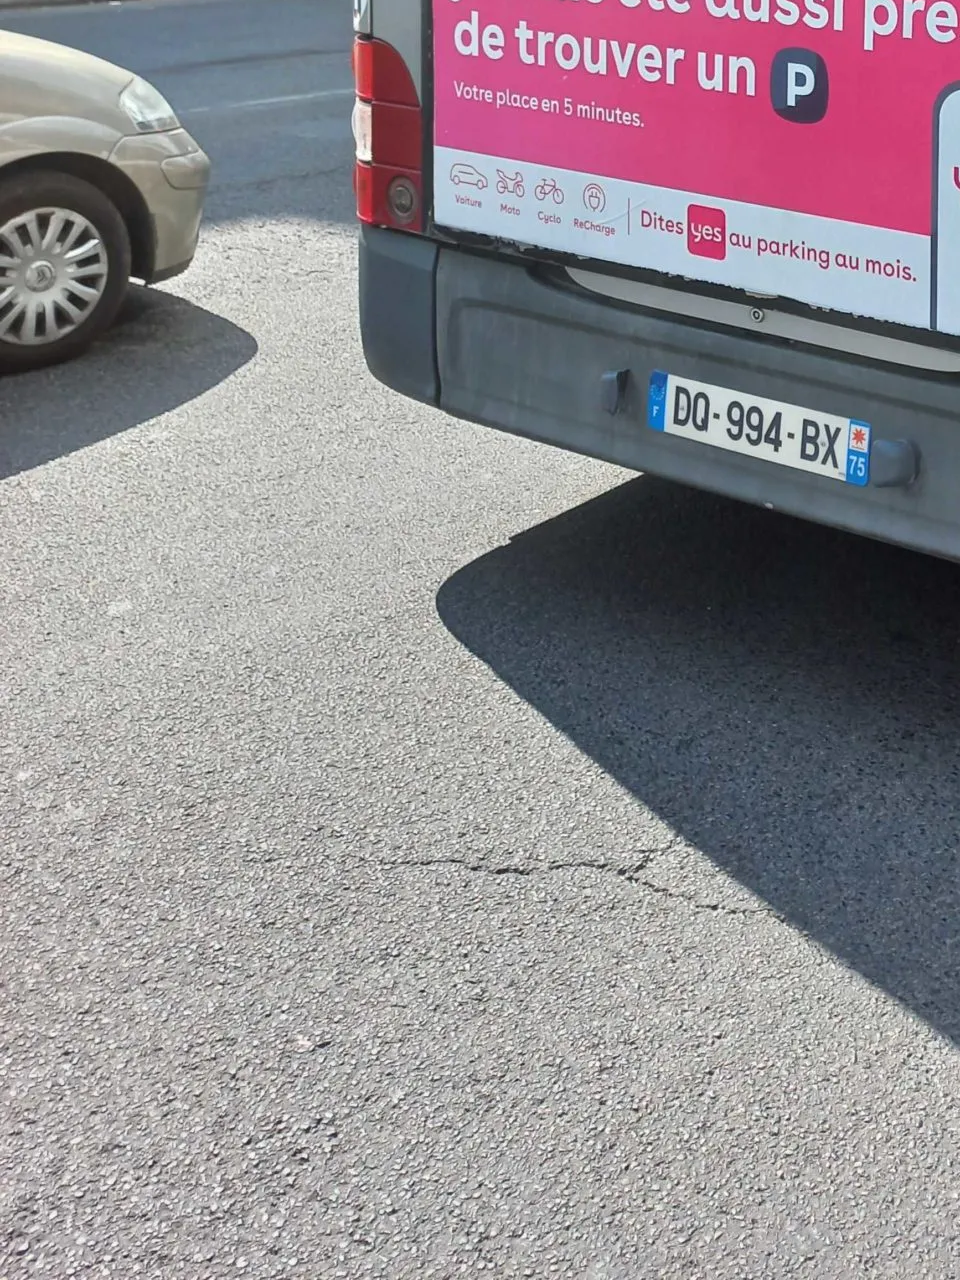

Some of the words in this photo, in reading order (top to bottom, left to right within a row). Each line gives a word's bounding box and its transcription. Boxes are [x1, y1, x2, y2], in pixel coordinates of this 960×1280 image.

[454, 10, 505, 59] de
[514, 20, 685, 85] trouver
[697, 51, 755, 96] un
[786, 62, 815, 107] P
[453, 80, 493, 103] Votre
[496, 88, 538, 111] place
[541, 99, 559, 114] en
[563, 98, 573, 116] 5
[577, 102, 645, 128] minutes.
[455, 195, 482, 208] Voiture
[500, 203, 521, 216] Moto
[538, 211, 561, 224] Cyclo
[573, 218, 615, 236] ReCharge
[641, 209, 684, 235] Dites
[691, 221, 722, 243] yes
[729, 230, 751, 249] au
[757, 235, 829, 270] parking
[835, 248, 859, 271] au
[866, 258, 917, 283] mois.
[652, 406, 660, 417] F
[673, 385, 842, 469] DQ-994-BX
[849, 455, 865, 477] 75
